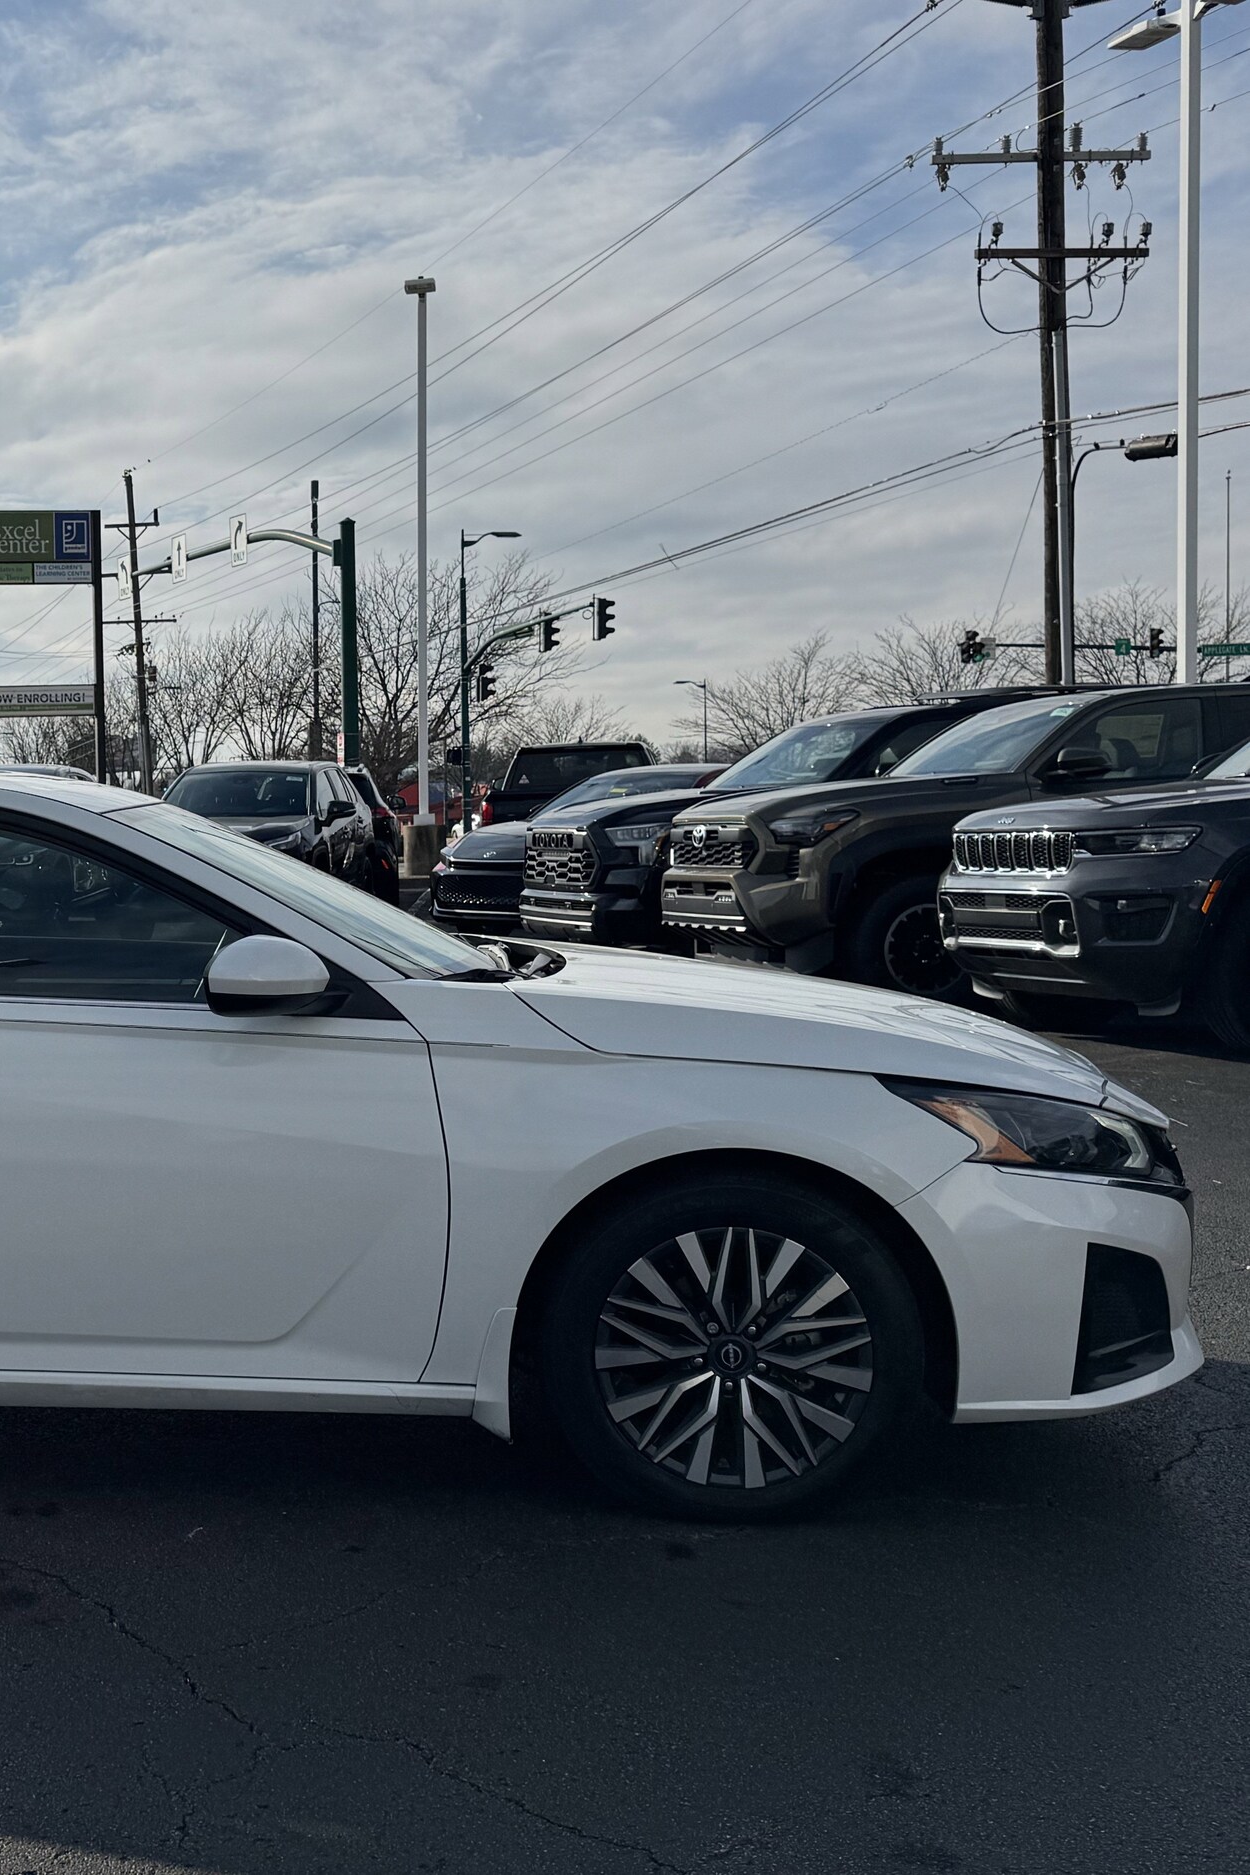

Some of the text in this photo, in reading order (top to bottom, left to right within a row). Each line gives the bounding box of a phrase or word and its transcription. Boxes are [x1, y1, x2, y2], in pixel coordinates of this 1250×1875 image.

[1204, 645, 1236, 655] APPLEGATE
[17, 692, 85, 703] ENROLLING!
[535, 834, 569, 847] TOYOTA
